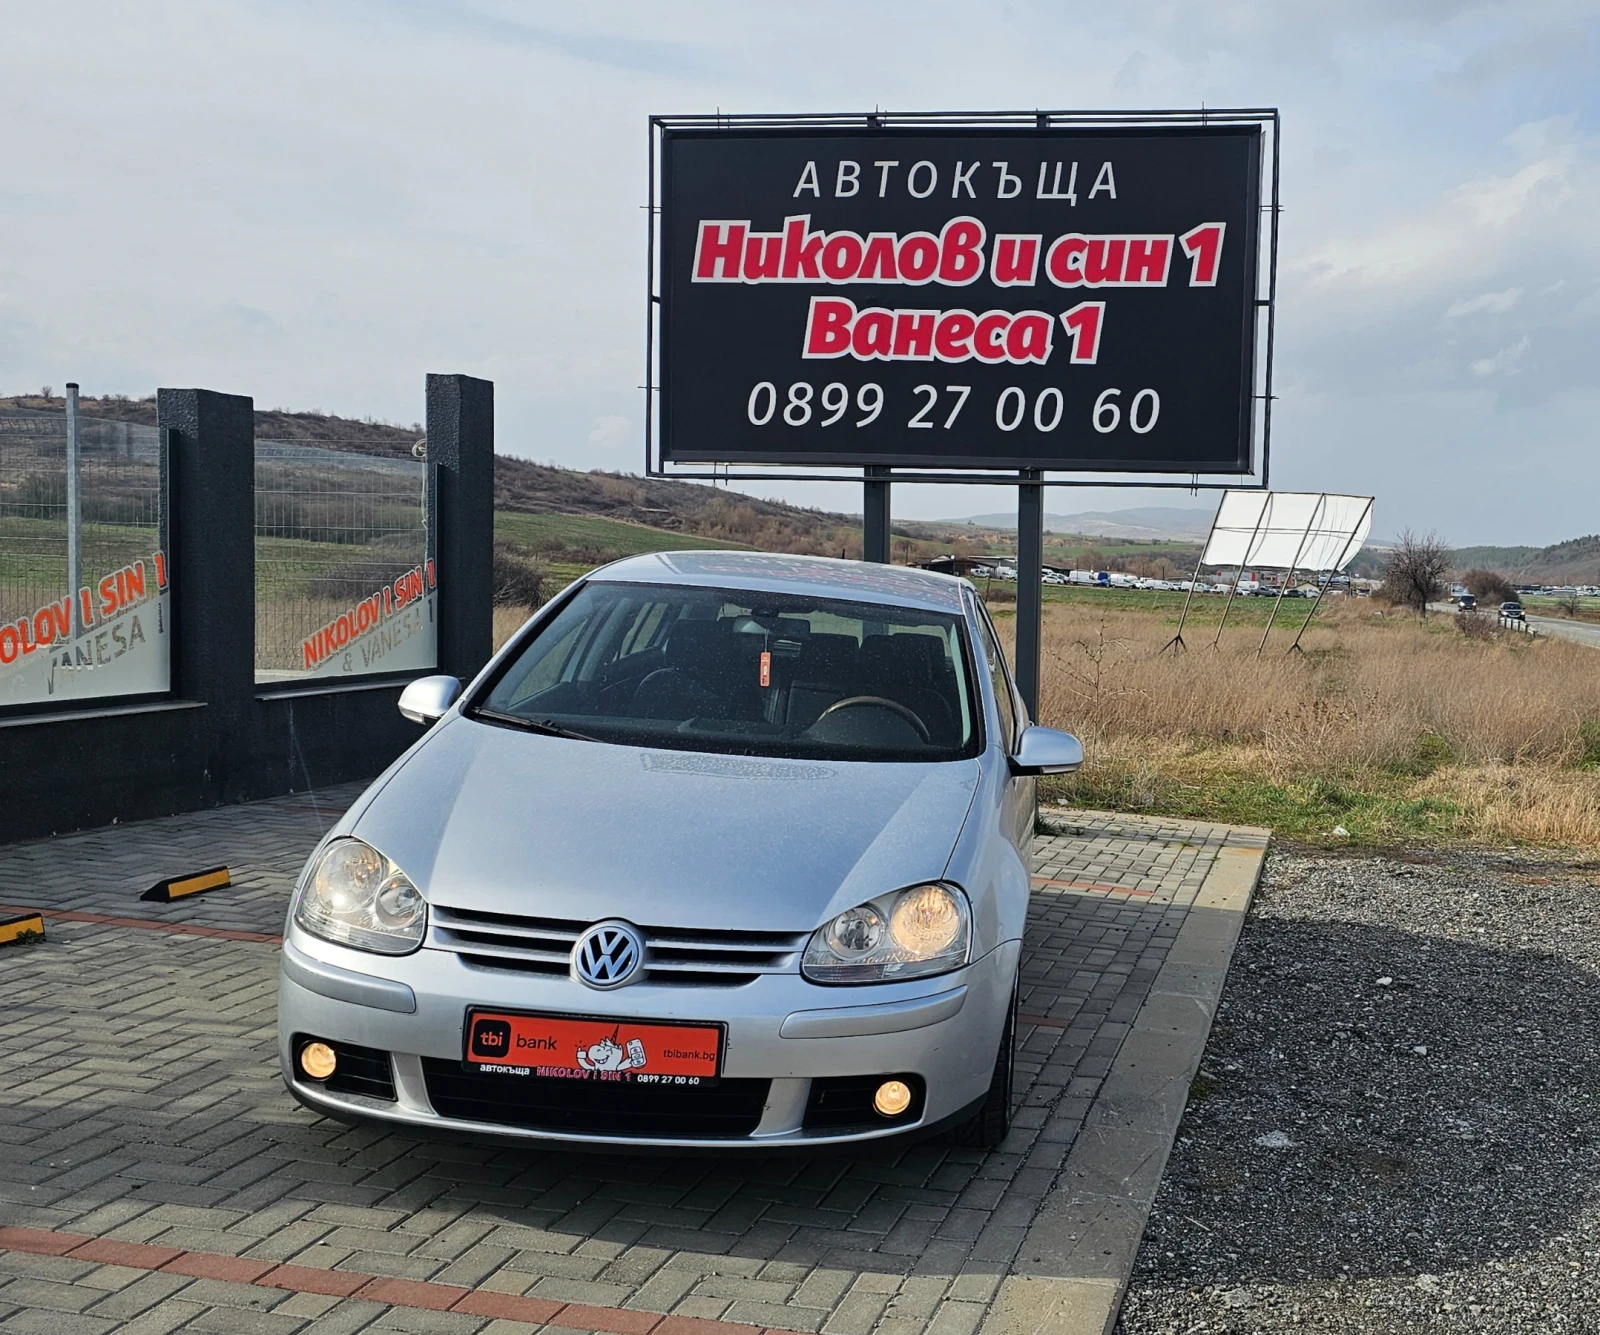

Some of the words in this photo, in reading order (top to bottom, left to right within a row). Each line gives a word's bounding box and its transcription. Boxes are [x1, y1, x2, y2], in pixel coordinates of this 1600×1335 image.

[793, 161, 1118, 206] АВТОКЪЩА
[692, 214, 986, 284] Николов
[991, 233, 1042, 287] и
[1045, 233, 1174, 287] син
[1179, 222, 1226, 287] 1
[802, 296, 1055, 365] Ванеса
[1060, 301, 1106, 365] 1
[747, 382, 884, 428] 0899
[907, 384, 972, 430] 27
[996, 387, 1064, 433] 00
[1093, 388, 1160, 434] 60
[79, 586, 95, 628] I
[98, 560, 146, 617] SIN
[153, 551, 168, 589] 1
[302, 592, 381, 669] NIKOLOV
[394, 565, 424, 610] SIN
[426, 558, 436, 588] 1
[360, 608, 424, 668] VANESA
[480, 1031, 504, 1047] tbi
[516, 1033, 557, 1050] bank
[663, 1049, 715, 1062] tbibank.bg
[479, 1063, 530, 1077] автокъща
[536, 1066, 591, 1079] NIKOLOV
[600, 1071, 621, 1081] SIN
[624, 1072, 631, 1082] 1
[637, 1074, 660, 1083] 0899
[661, 1075, 673, 1084] 27
[674, 1076, 686, 1084] 00
[688, 1077, 700, 1085] 60
